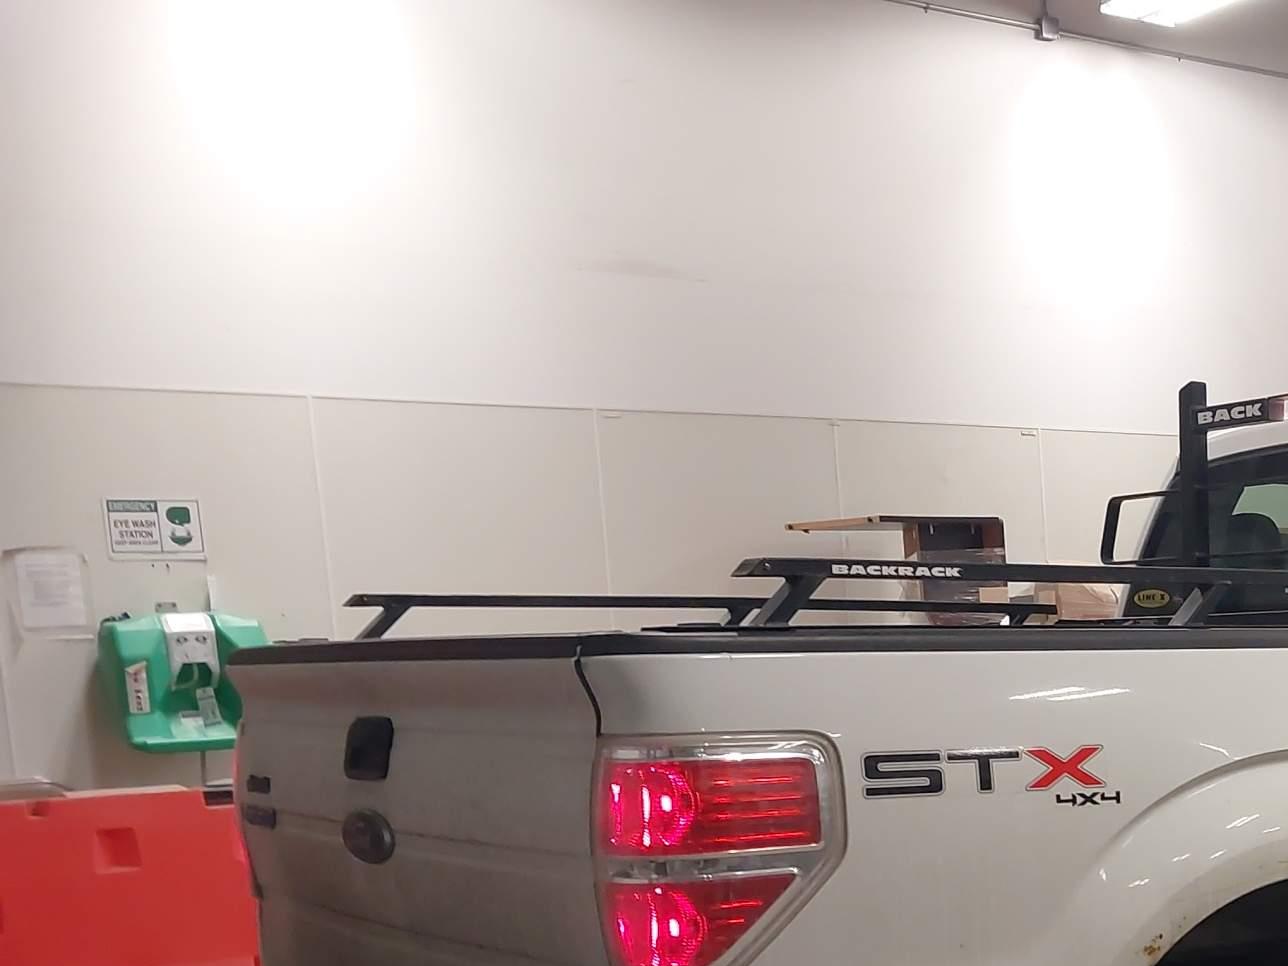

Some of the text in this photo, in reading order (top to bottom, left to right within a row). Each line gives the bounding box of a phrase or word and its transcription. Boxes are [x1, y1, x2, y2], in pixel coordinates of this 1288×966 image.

[1197, 403, 1262, 425] BACK
[113, 519, 156, 529] EYE WASH
[119, 530, 154, 539] STATION
[831, 563, 962, 579] BACKRACK
[861, 745, 1106, 800] STX
